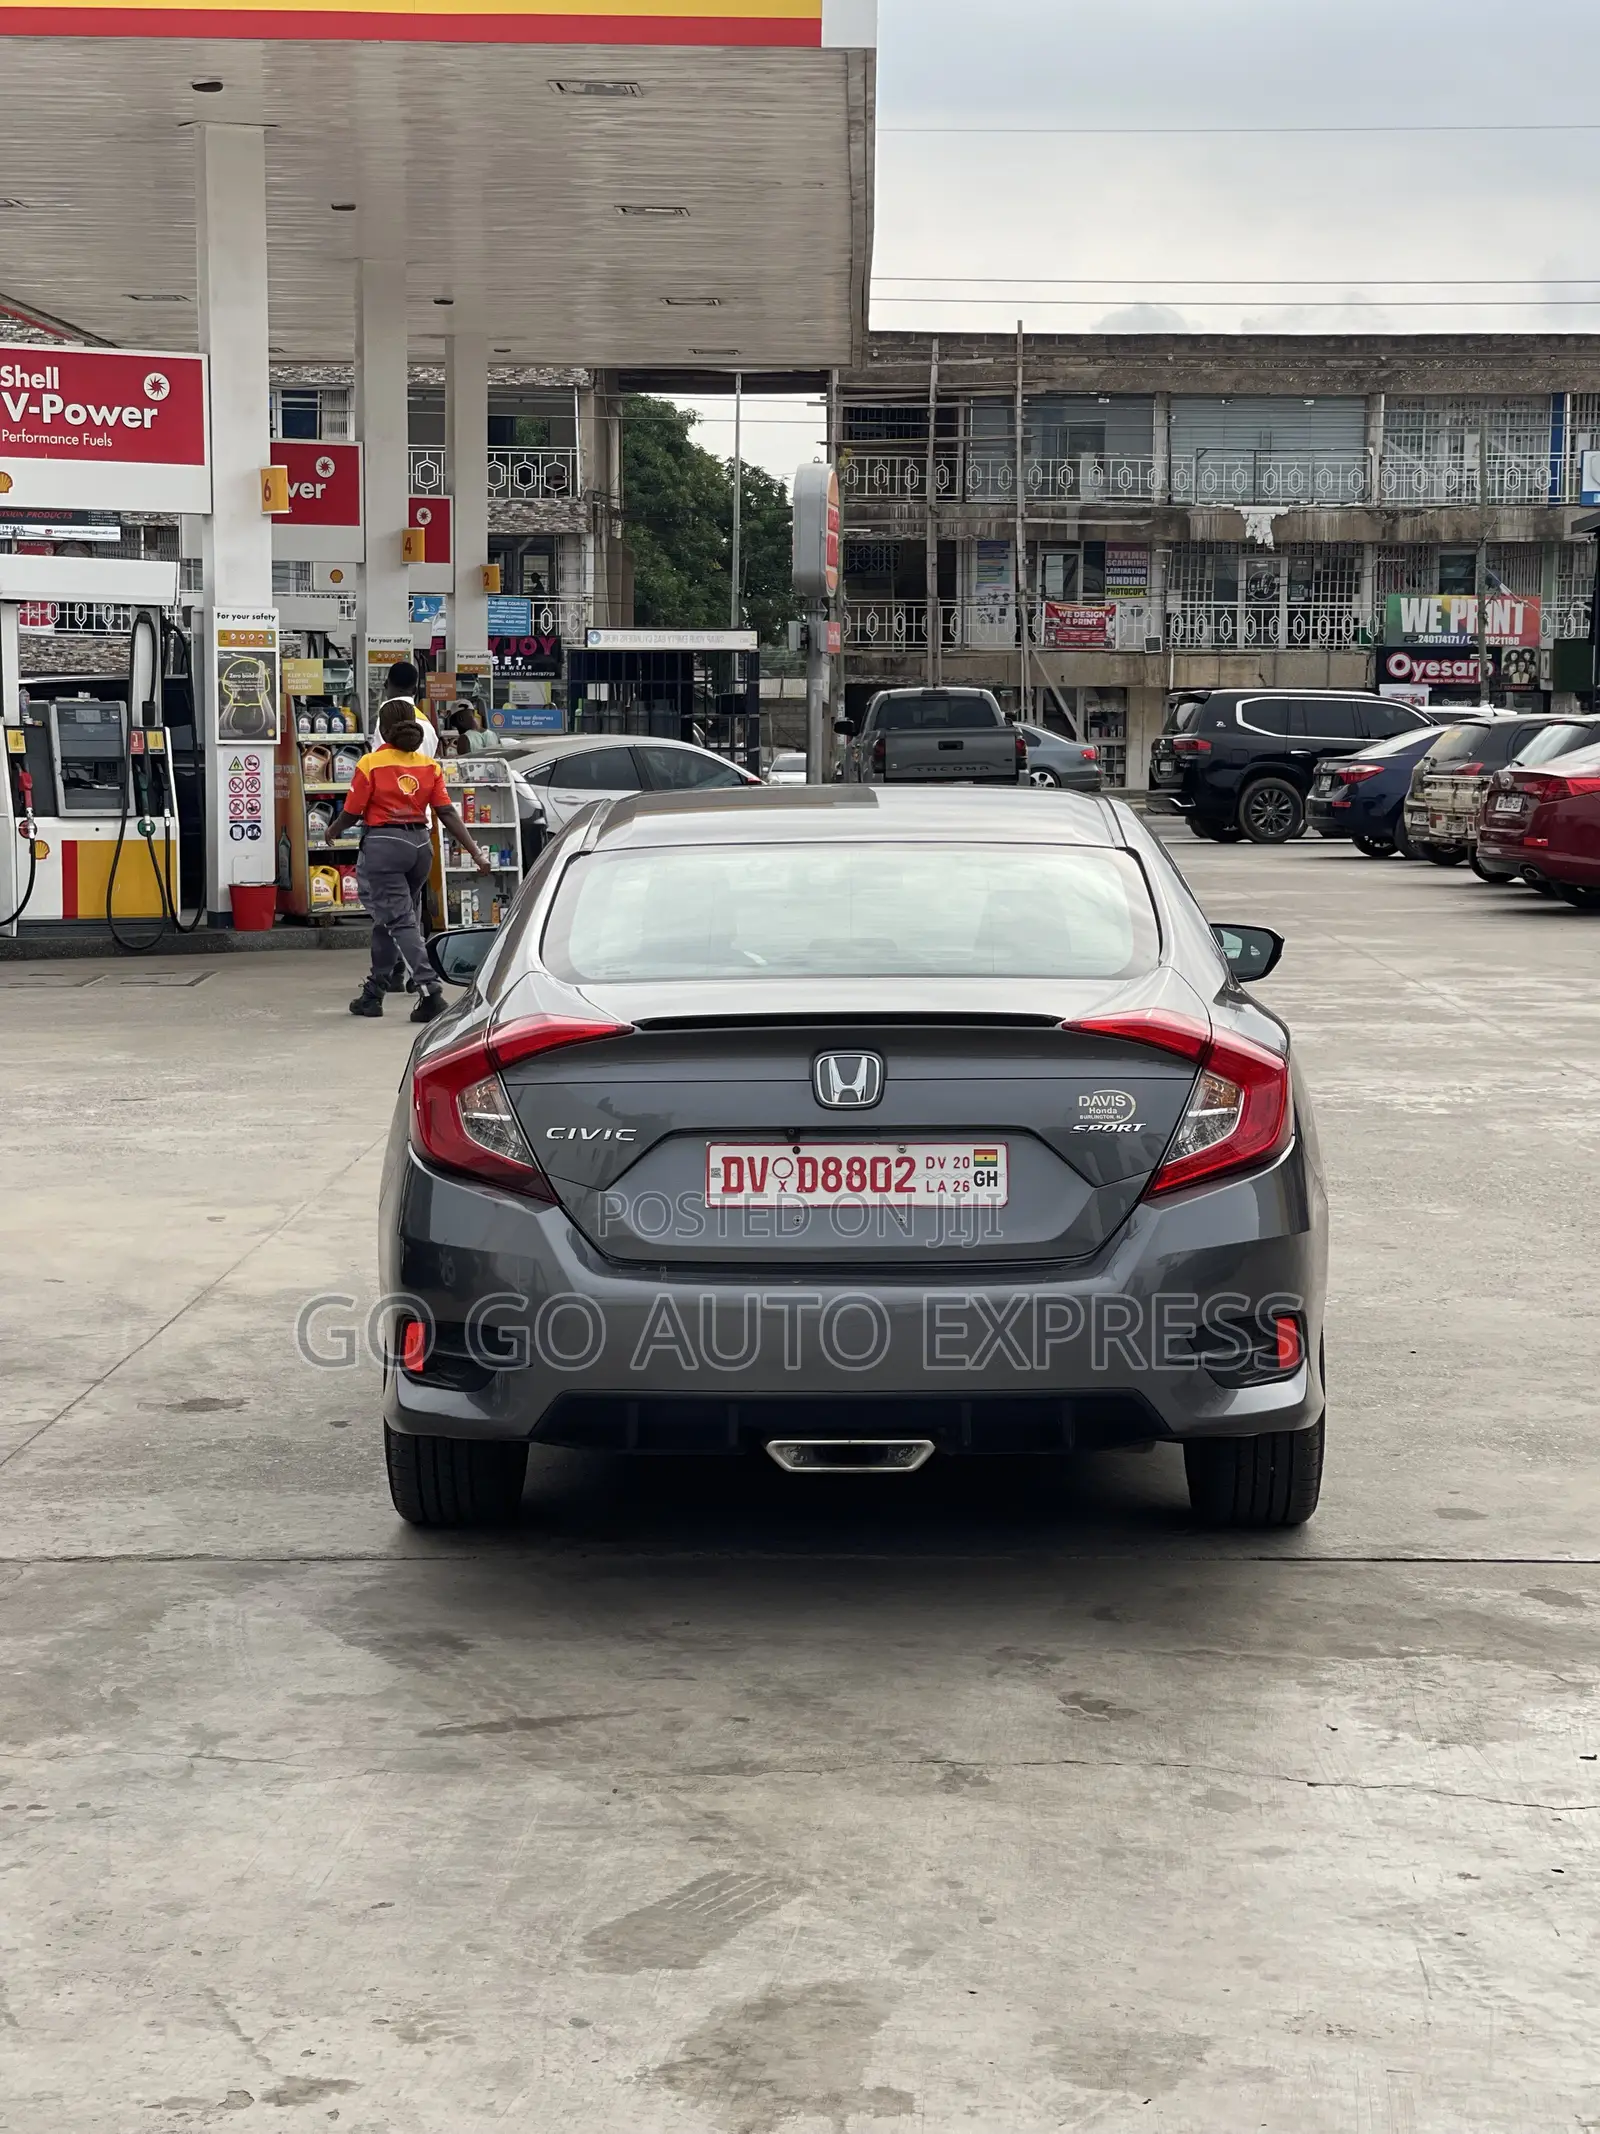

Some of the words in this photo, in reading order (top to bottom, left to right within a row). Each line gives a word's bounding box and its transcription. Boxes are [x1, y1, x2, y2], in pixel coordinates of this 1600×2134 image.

[0, 365, 60, 390] Shell
[1, 392, 158, 429] V-Power
[2, 428, 79, 446] Performance
[83, 432, 113, 447] Fuels
[264, 478, 272, 502] 6
[26, 511, 73, 520] PRODUCTS
[404, 537, 412, 555] 4
[1107, 551, 1147, 559] TYPING
[483, 571, 490, 587] 2
[217, 612, 229, 620] For
[252, 612, 276, 622] safety
[1400, 598, 1443, 633] WE
[1450, 598, 1528, 634] PRINT
[1078, 1096, 1126, 1107] DAVIS
[546, 1127, 638, 1141] CIVIC
[1070, 1123, 1146, 1134] SPORT
[926, 1156, 946, 1169] DV
[953, 1156, 970, 1169] 20
[721, 1156, 770, 1193] DV
[796, 1156, 916, 1193] D8802
[974, 1170, 998, 1187] GH
[926, 1180, 947, 1193] LA
[953, 1180, 970, 1193] 26
